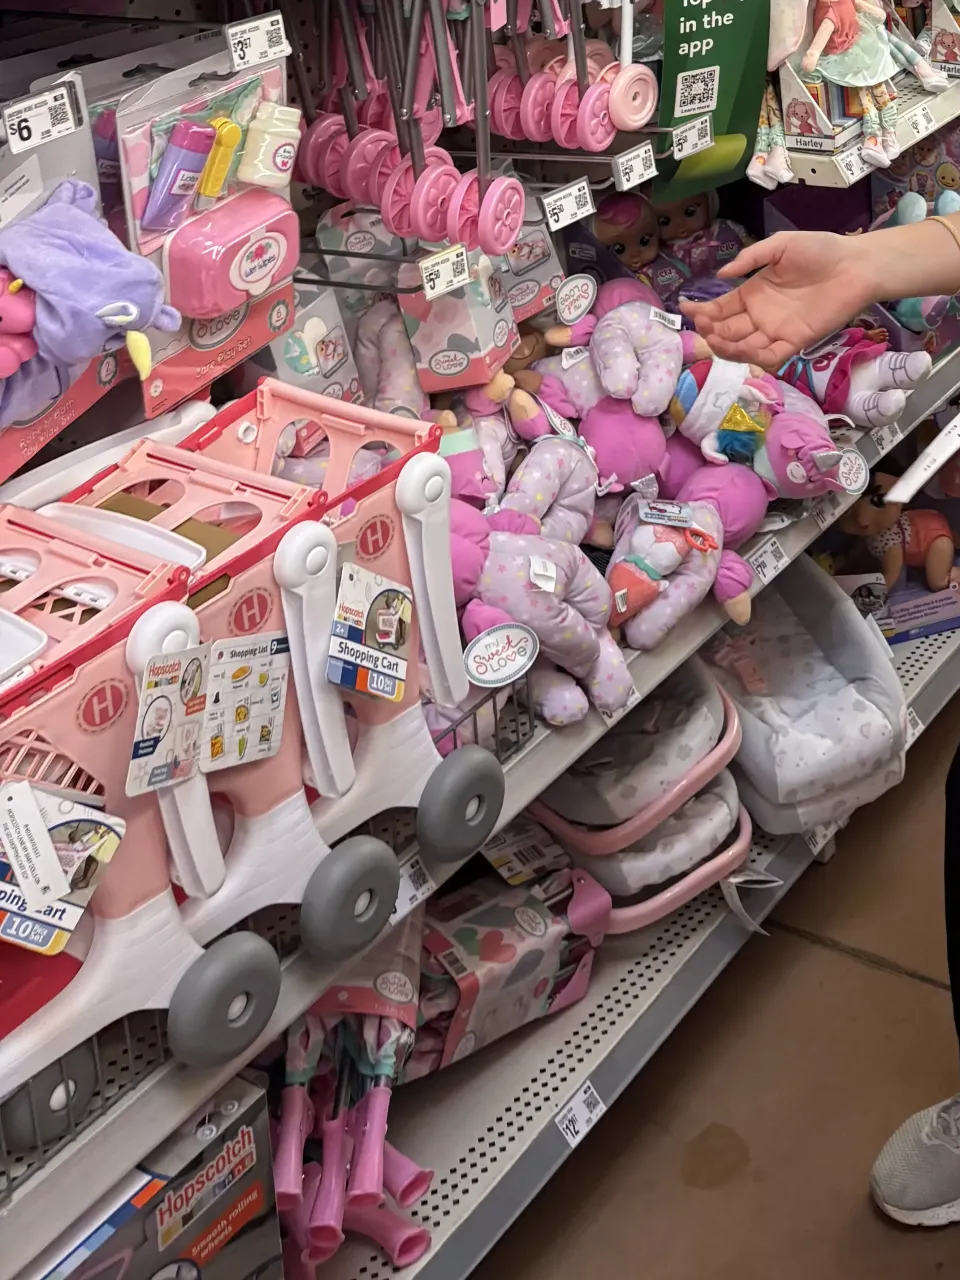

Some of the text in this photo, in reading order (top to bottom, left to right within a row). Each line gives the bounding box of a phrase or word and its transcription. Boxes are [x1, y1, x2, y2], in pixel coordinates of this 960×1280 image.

[679, 11, 734, 34] in the
[678, 38, 714, 58] app
[681, 106, 696, 114] Learn
[9, 118, 32, 142] $6
[796, 138, 823, 149] Harley
[238, 336, 252, 352] Set
[339, 603, 365, 619] Hopscotch
[335, 624, 345, 634] 2+
[230, 648, 257, 659] Shopping
[258, 645, 268, 654] List
[338, 641, 399, 674] Shopping Cart
[473, 635, 529, 675] Sweet
[149, 659, 182, 677] Hopscotch
[371, 673, 385, 690] 10
[7, 918, 31, 939] 10
[158, 1127, 254, 1226] Hopscotch
[192, 1189, 259, 1256] Smooth rolling
[201, 1225, 233, 1258] wheels
